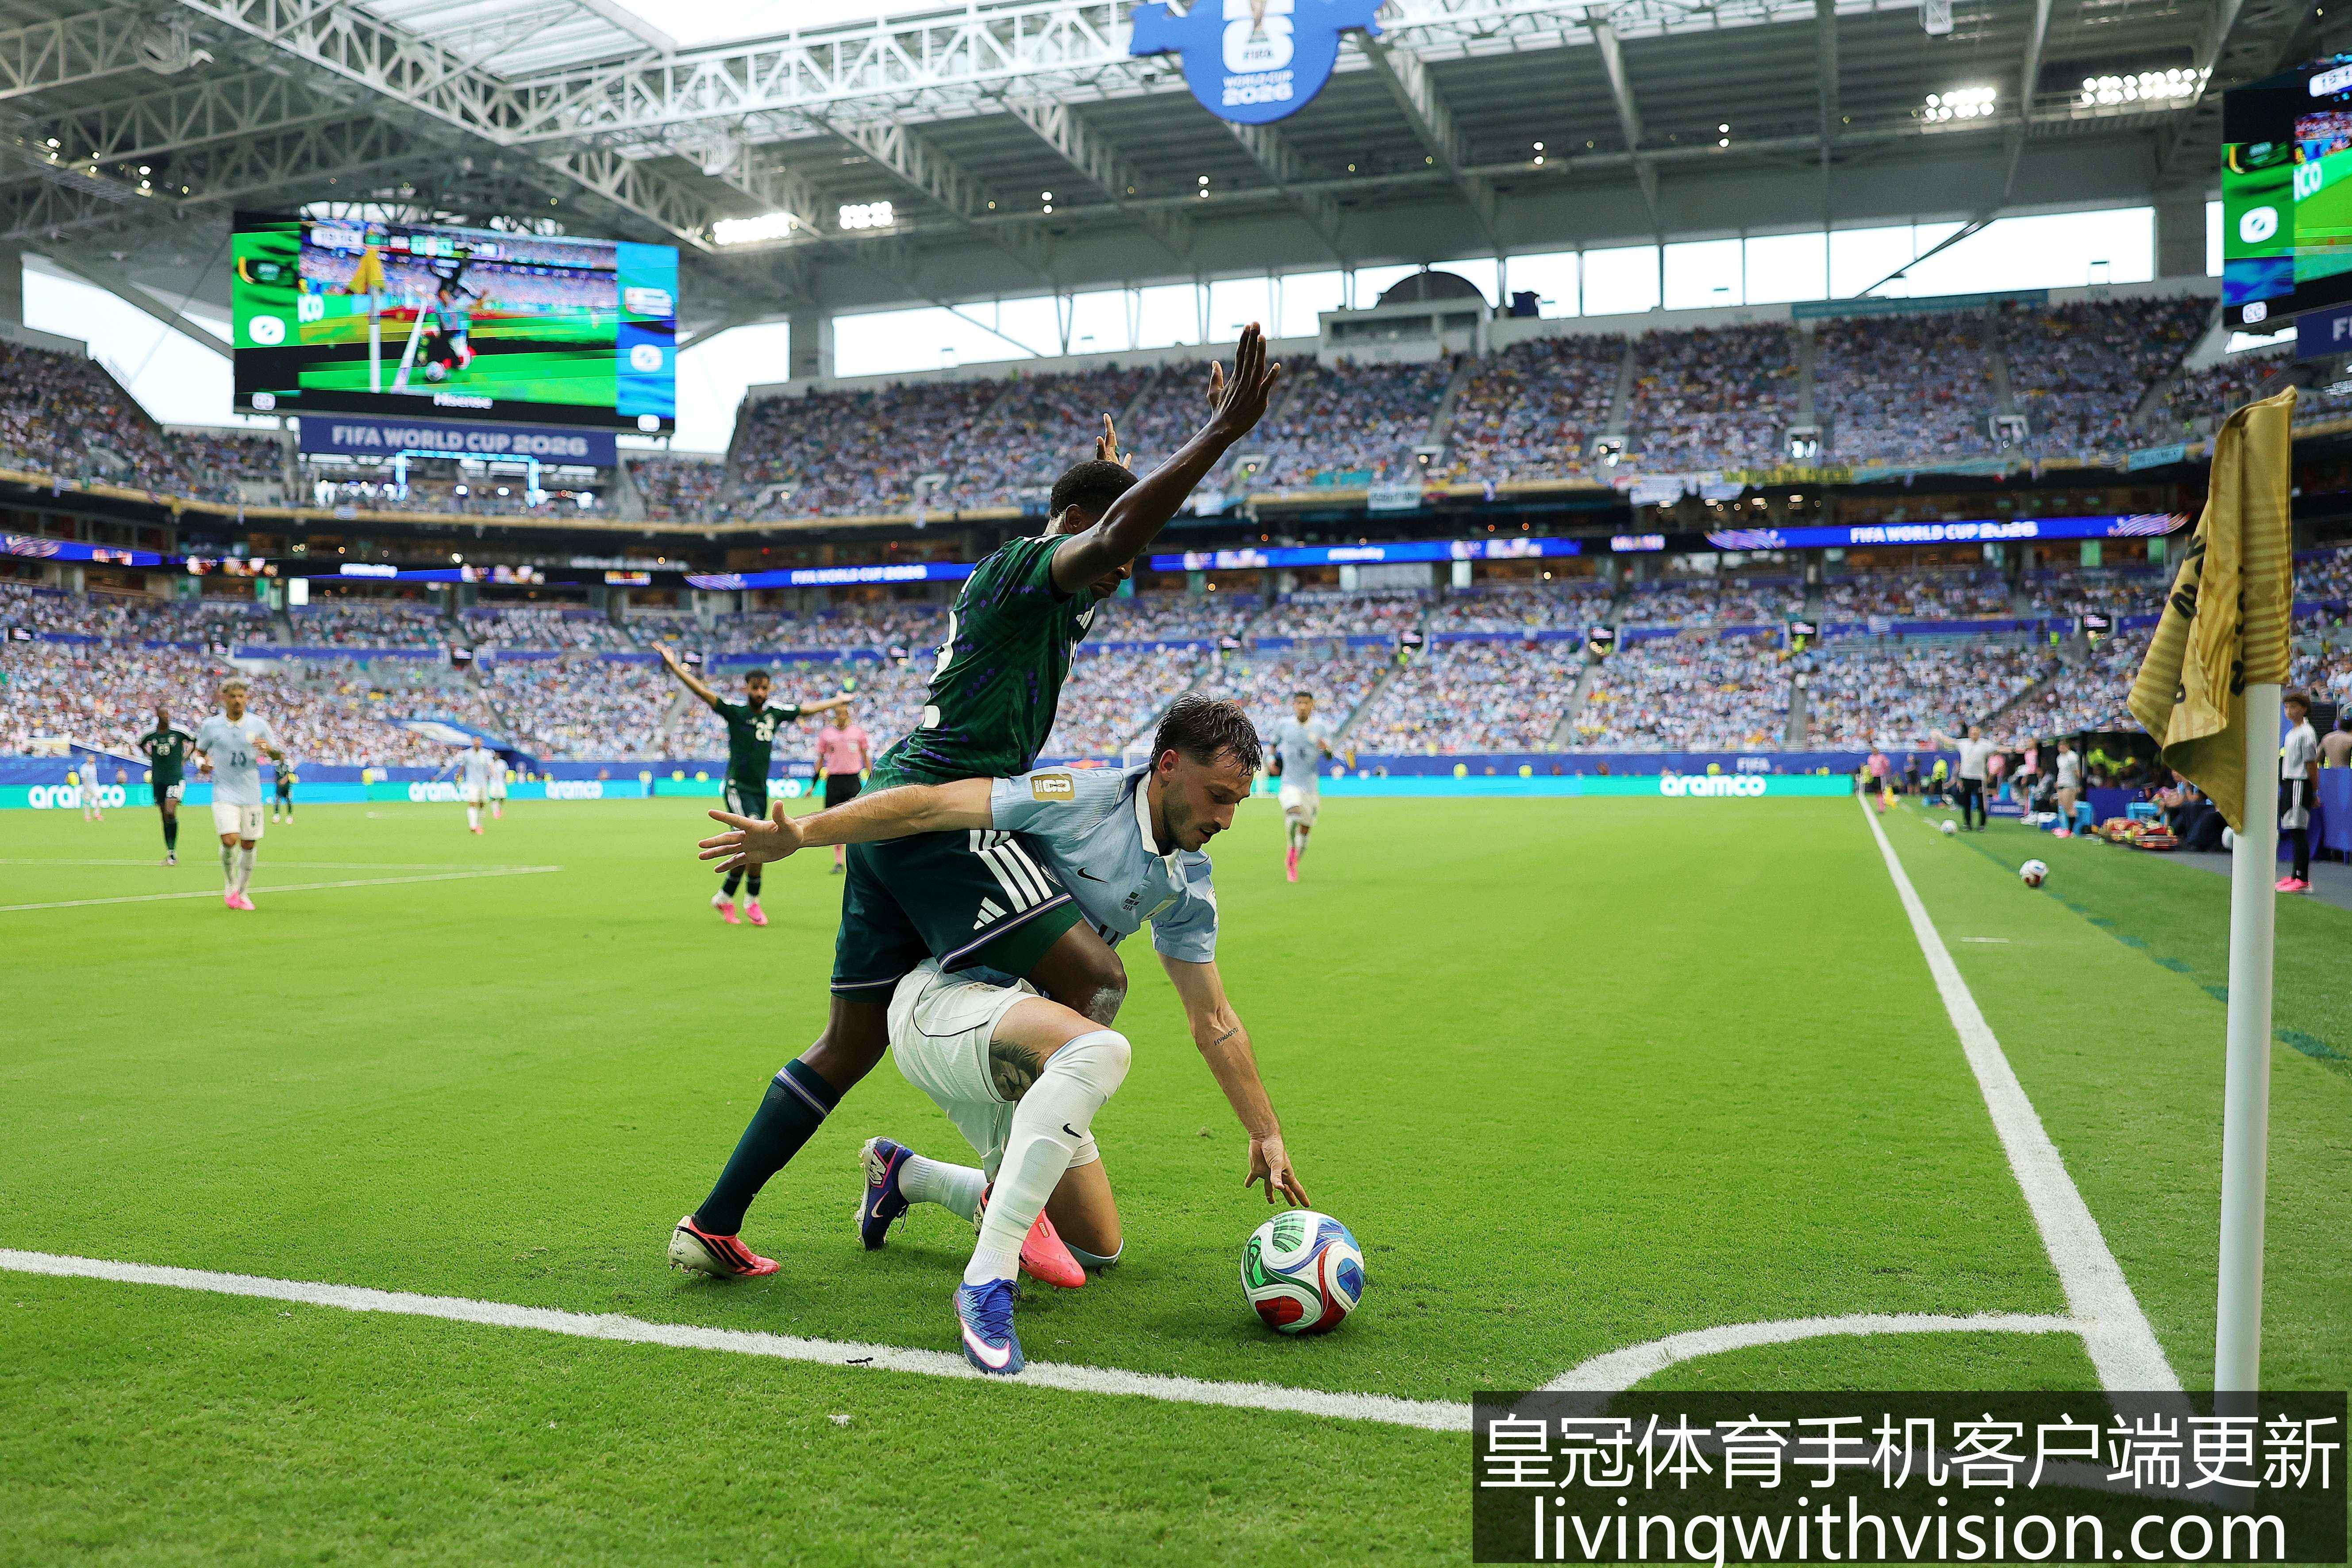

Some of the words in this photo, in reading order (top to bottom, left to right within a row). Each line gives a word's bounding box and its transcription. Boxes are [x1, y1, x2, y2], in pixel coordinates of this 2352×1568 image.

[1222, 73, 1268, 89] WORLD
[1267, 69, 1295, 86] CUP
[1221, 81, 1294, 107] 2026
[332, 425, 382, 446] FIFA
[383, 427, 465, 450] WORLD
[465, 432, 512, 452] CUP
[512, 434, 589, 457] 2026
[1850, 526, 1886, 543] FIFA
[1886, 524, 1944, 542] WORLD
[1944, 523, 1979, 540] CUP
[791, 570, 816, 585] FIFA
[816, 568, 859, 584] WORLD
[859, 567, 883, 582] CUP
[883, 564, 928, 581] 2026
[545, 780, 604, 799] aramco
[1660, 774, 1767, 797] aramco
